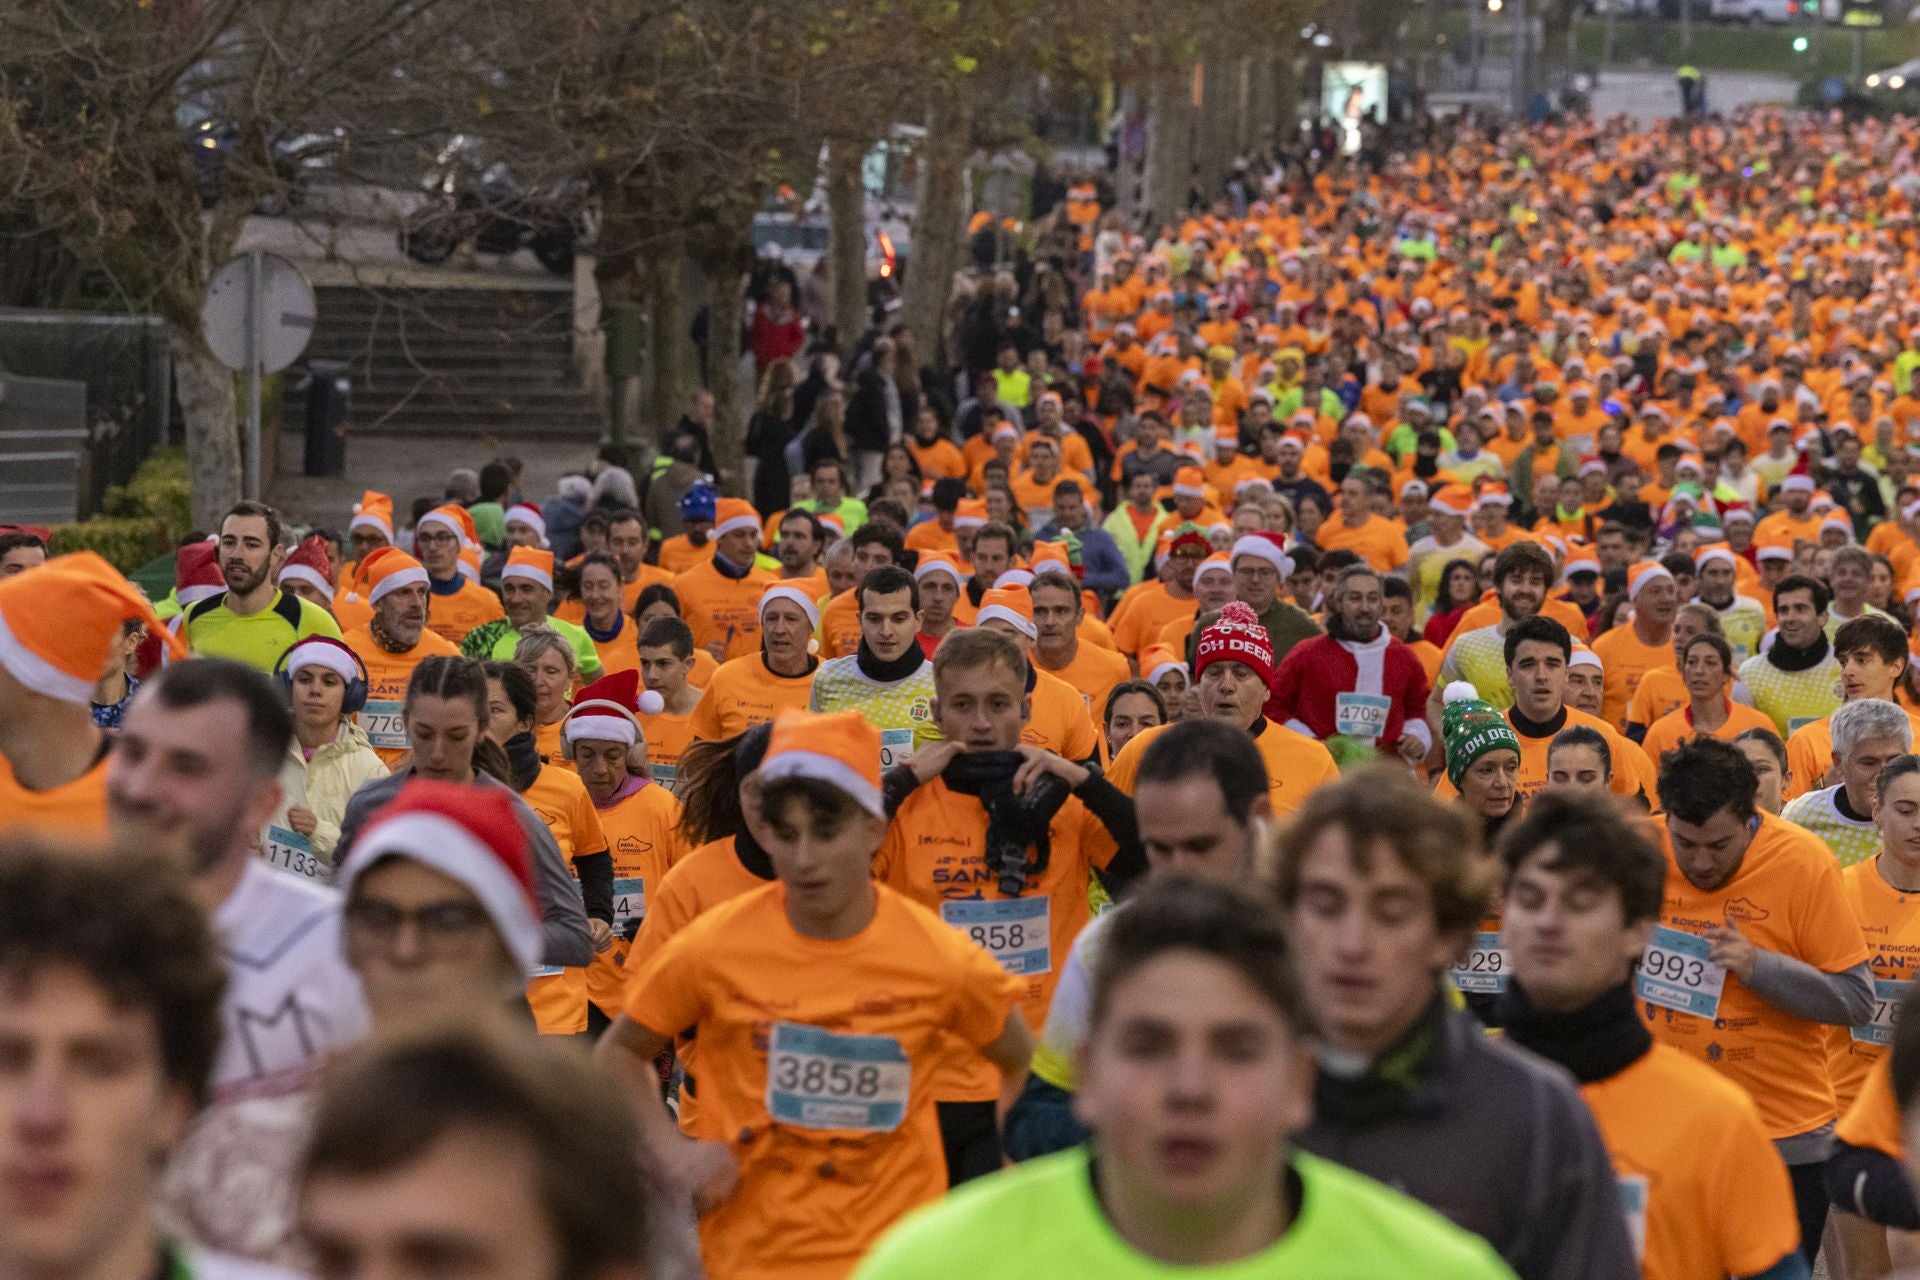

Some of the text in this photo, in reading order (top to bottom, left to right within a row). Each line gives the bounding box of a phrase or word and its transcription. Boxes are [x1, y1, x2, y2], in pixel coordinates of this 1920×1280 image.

[1199, 639, 1272, 667] OH DEER!
[1340, 705, 1380, 722] 4709
[1464, 728, 1520, 754] OH DEE
[269, 844, 318, 878] 1133
[933, 868, 991, 883] SAN
[969, 924, 1024, 950] 858
[1872, 955, 1905, 969] AN
[775, 1055, 880, 1098] 3858
